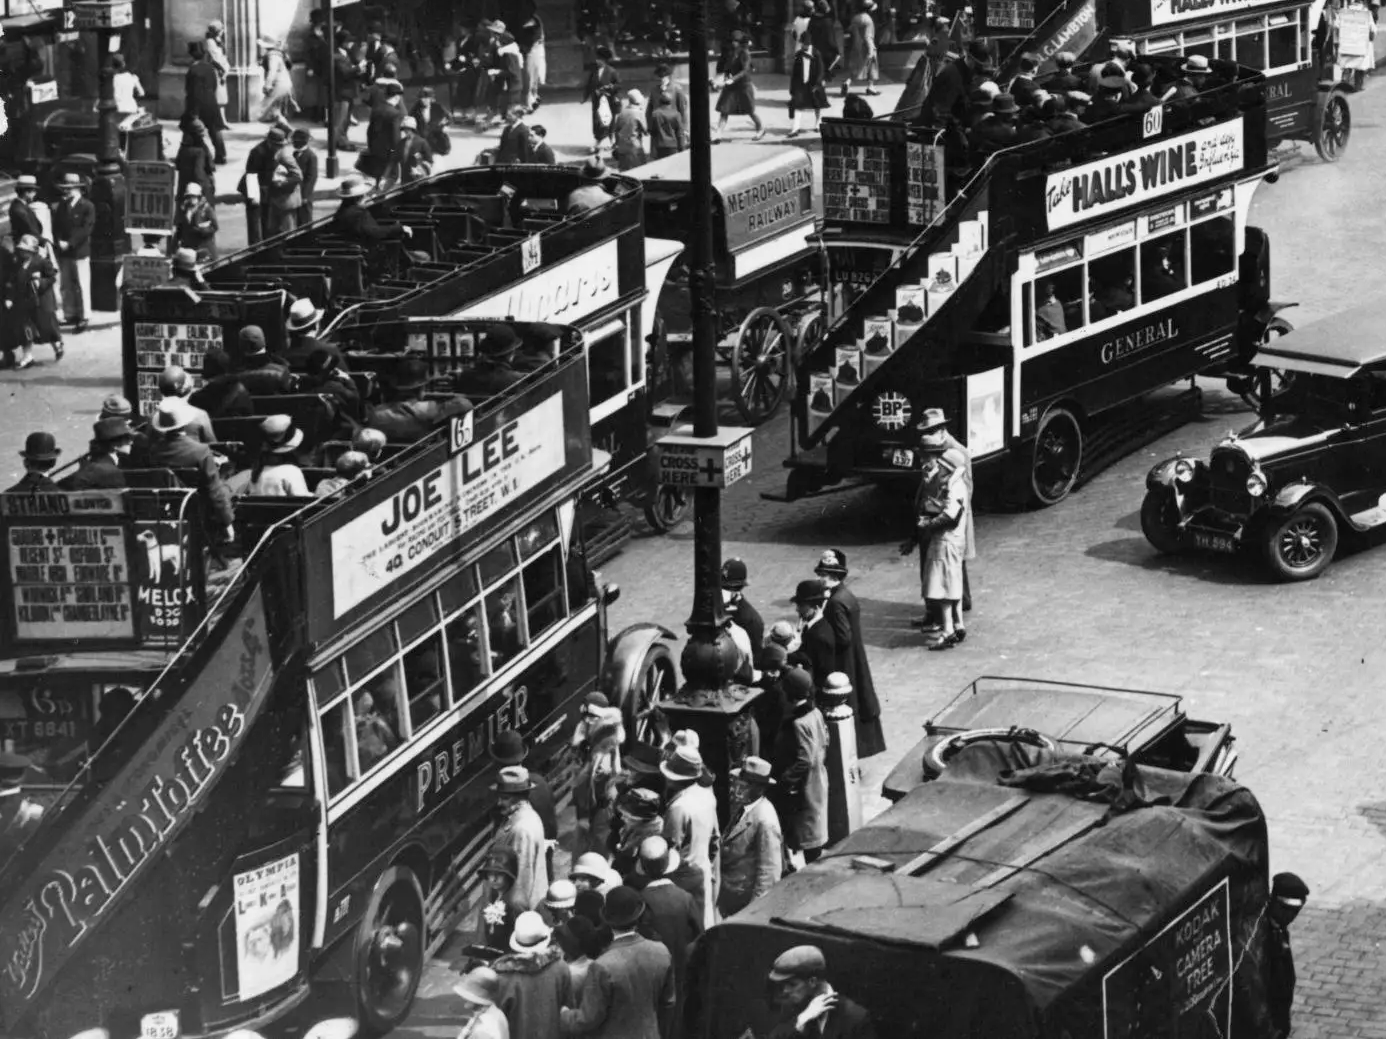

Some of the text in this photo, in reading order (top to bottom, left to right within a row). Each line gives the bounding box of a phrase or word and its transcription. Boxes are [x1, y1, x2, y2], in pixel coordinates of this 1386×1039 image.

[1145, 109, 1161, 134] 60
[727, 168, 812, 214] METROPOLITAN
[1048, 140, 1198, 213] Take HALL'S WINE
[748, 198, 797, 232] RAILWAY
[1101, 318, 1179, 364] GENERAL
[881, 401, 903, 417] BP
[381, 469, 442, 536] JOE
[461, 420, 520, 485] LEE
[406, 521, 450, 560] CONDUIT
[417, 685, 529, 813] PREMIER
[237, 857, 297, 887] OLYMPIA
[1176, 929, 1222, 978] CAMERA
